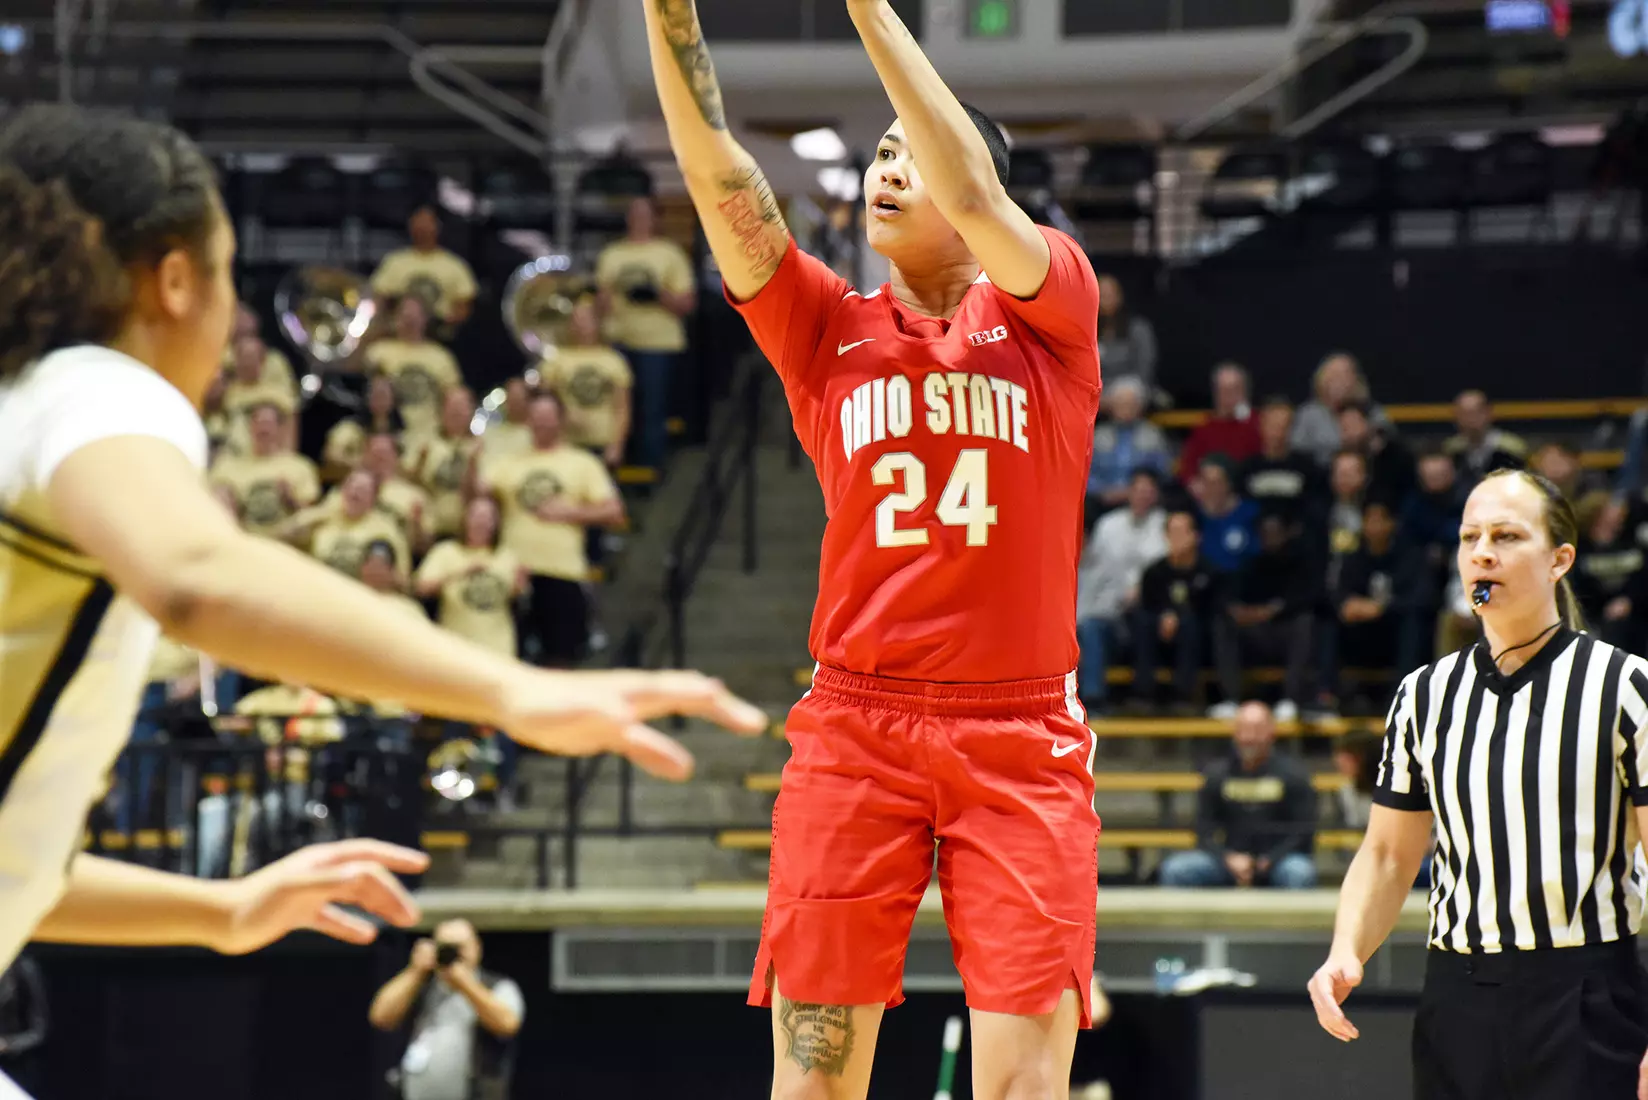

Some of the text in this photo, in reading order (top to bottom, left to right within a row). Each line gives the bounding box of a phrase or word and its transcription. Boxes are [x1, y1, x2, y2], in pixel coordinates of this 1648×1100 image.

[841, 372, 1030, 464] OHIO STATE
[870, 448, 998, 547] 24
